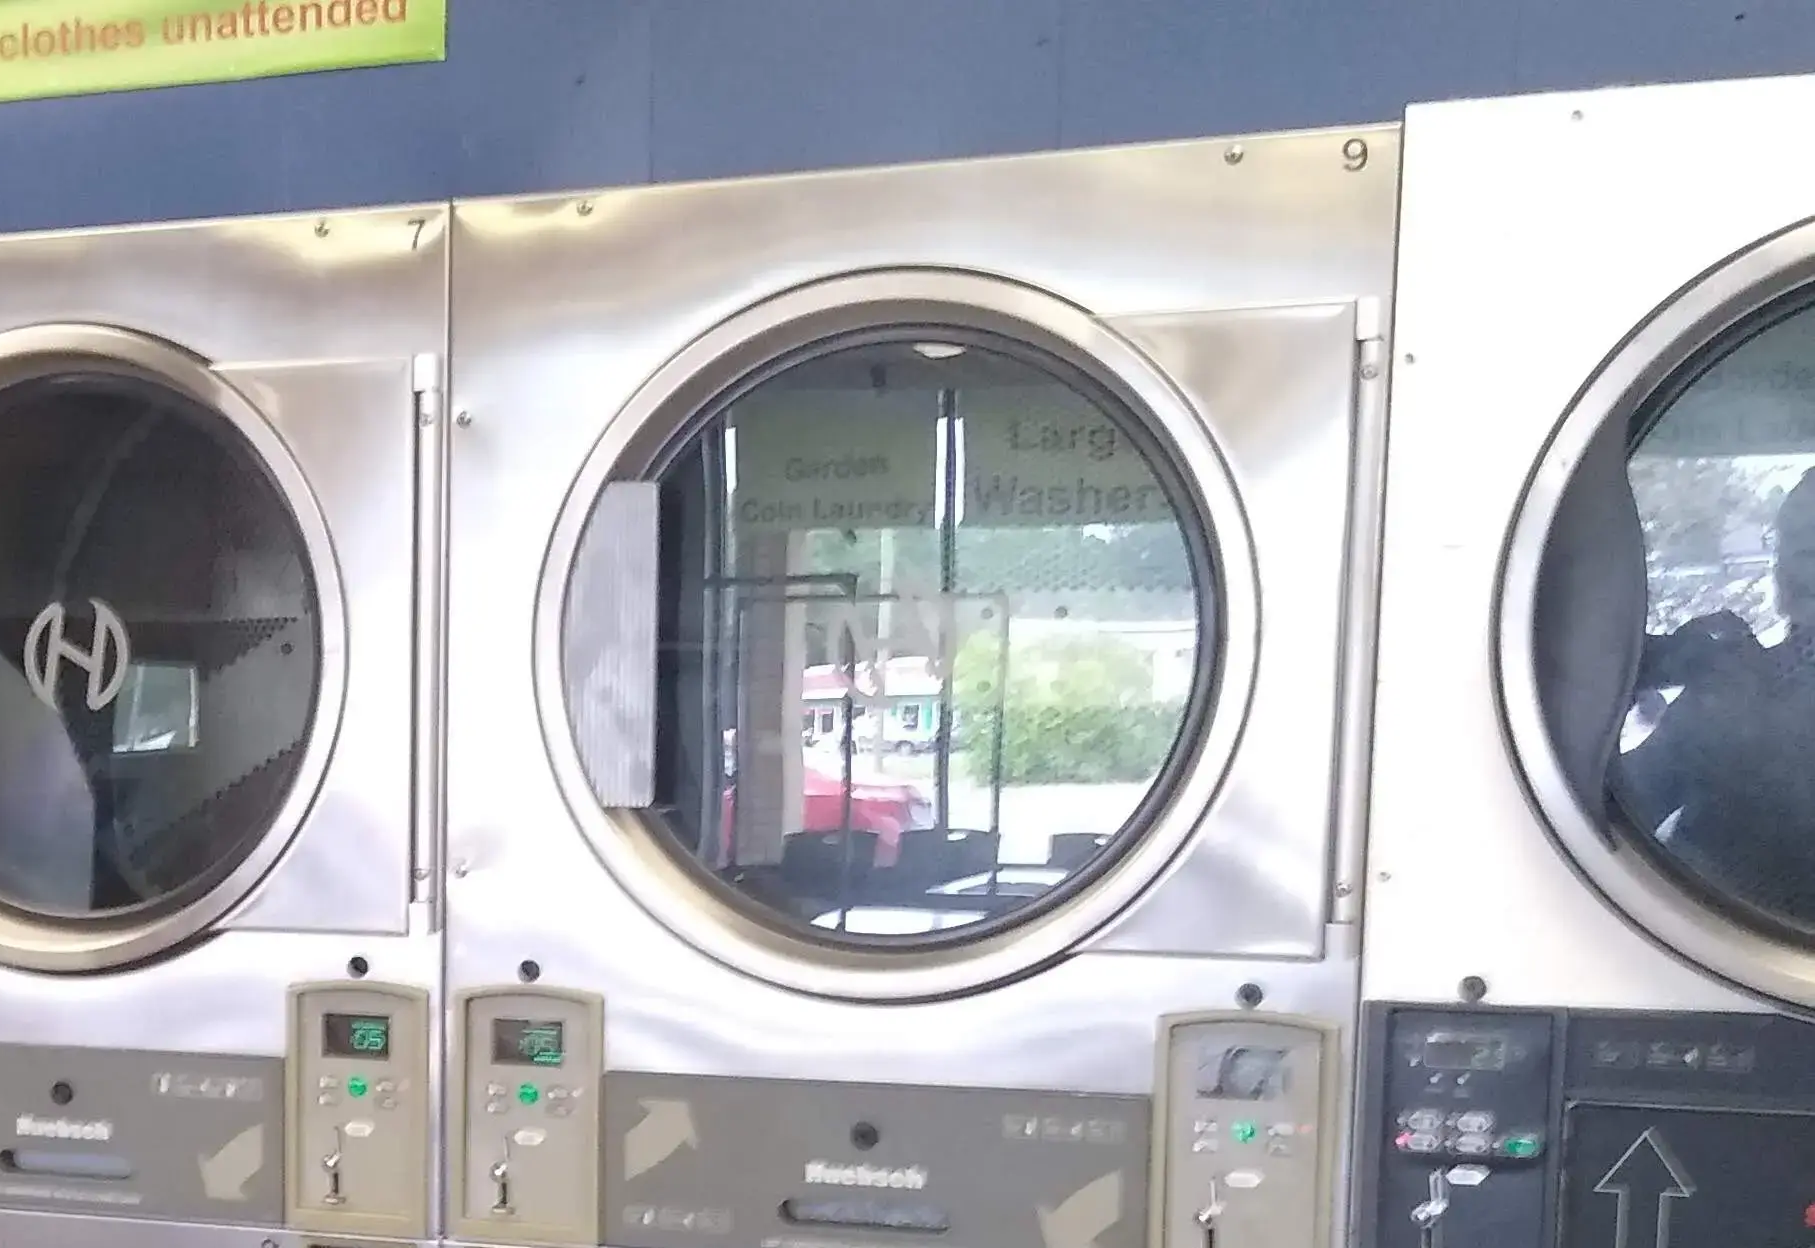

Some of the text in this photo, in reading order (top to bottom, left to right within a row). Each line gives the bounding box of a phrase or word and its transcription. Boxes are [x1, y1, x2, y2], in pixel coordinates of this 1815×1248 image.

[161, 0, 408, 45] unattended
[1342, 137, 1369, 172] 9
[407, 218, 426, 251] 7
